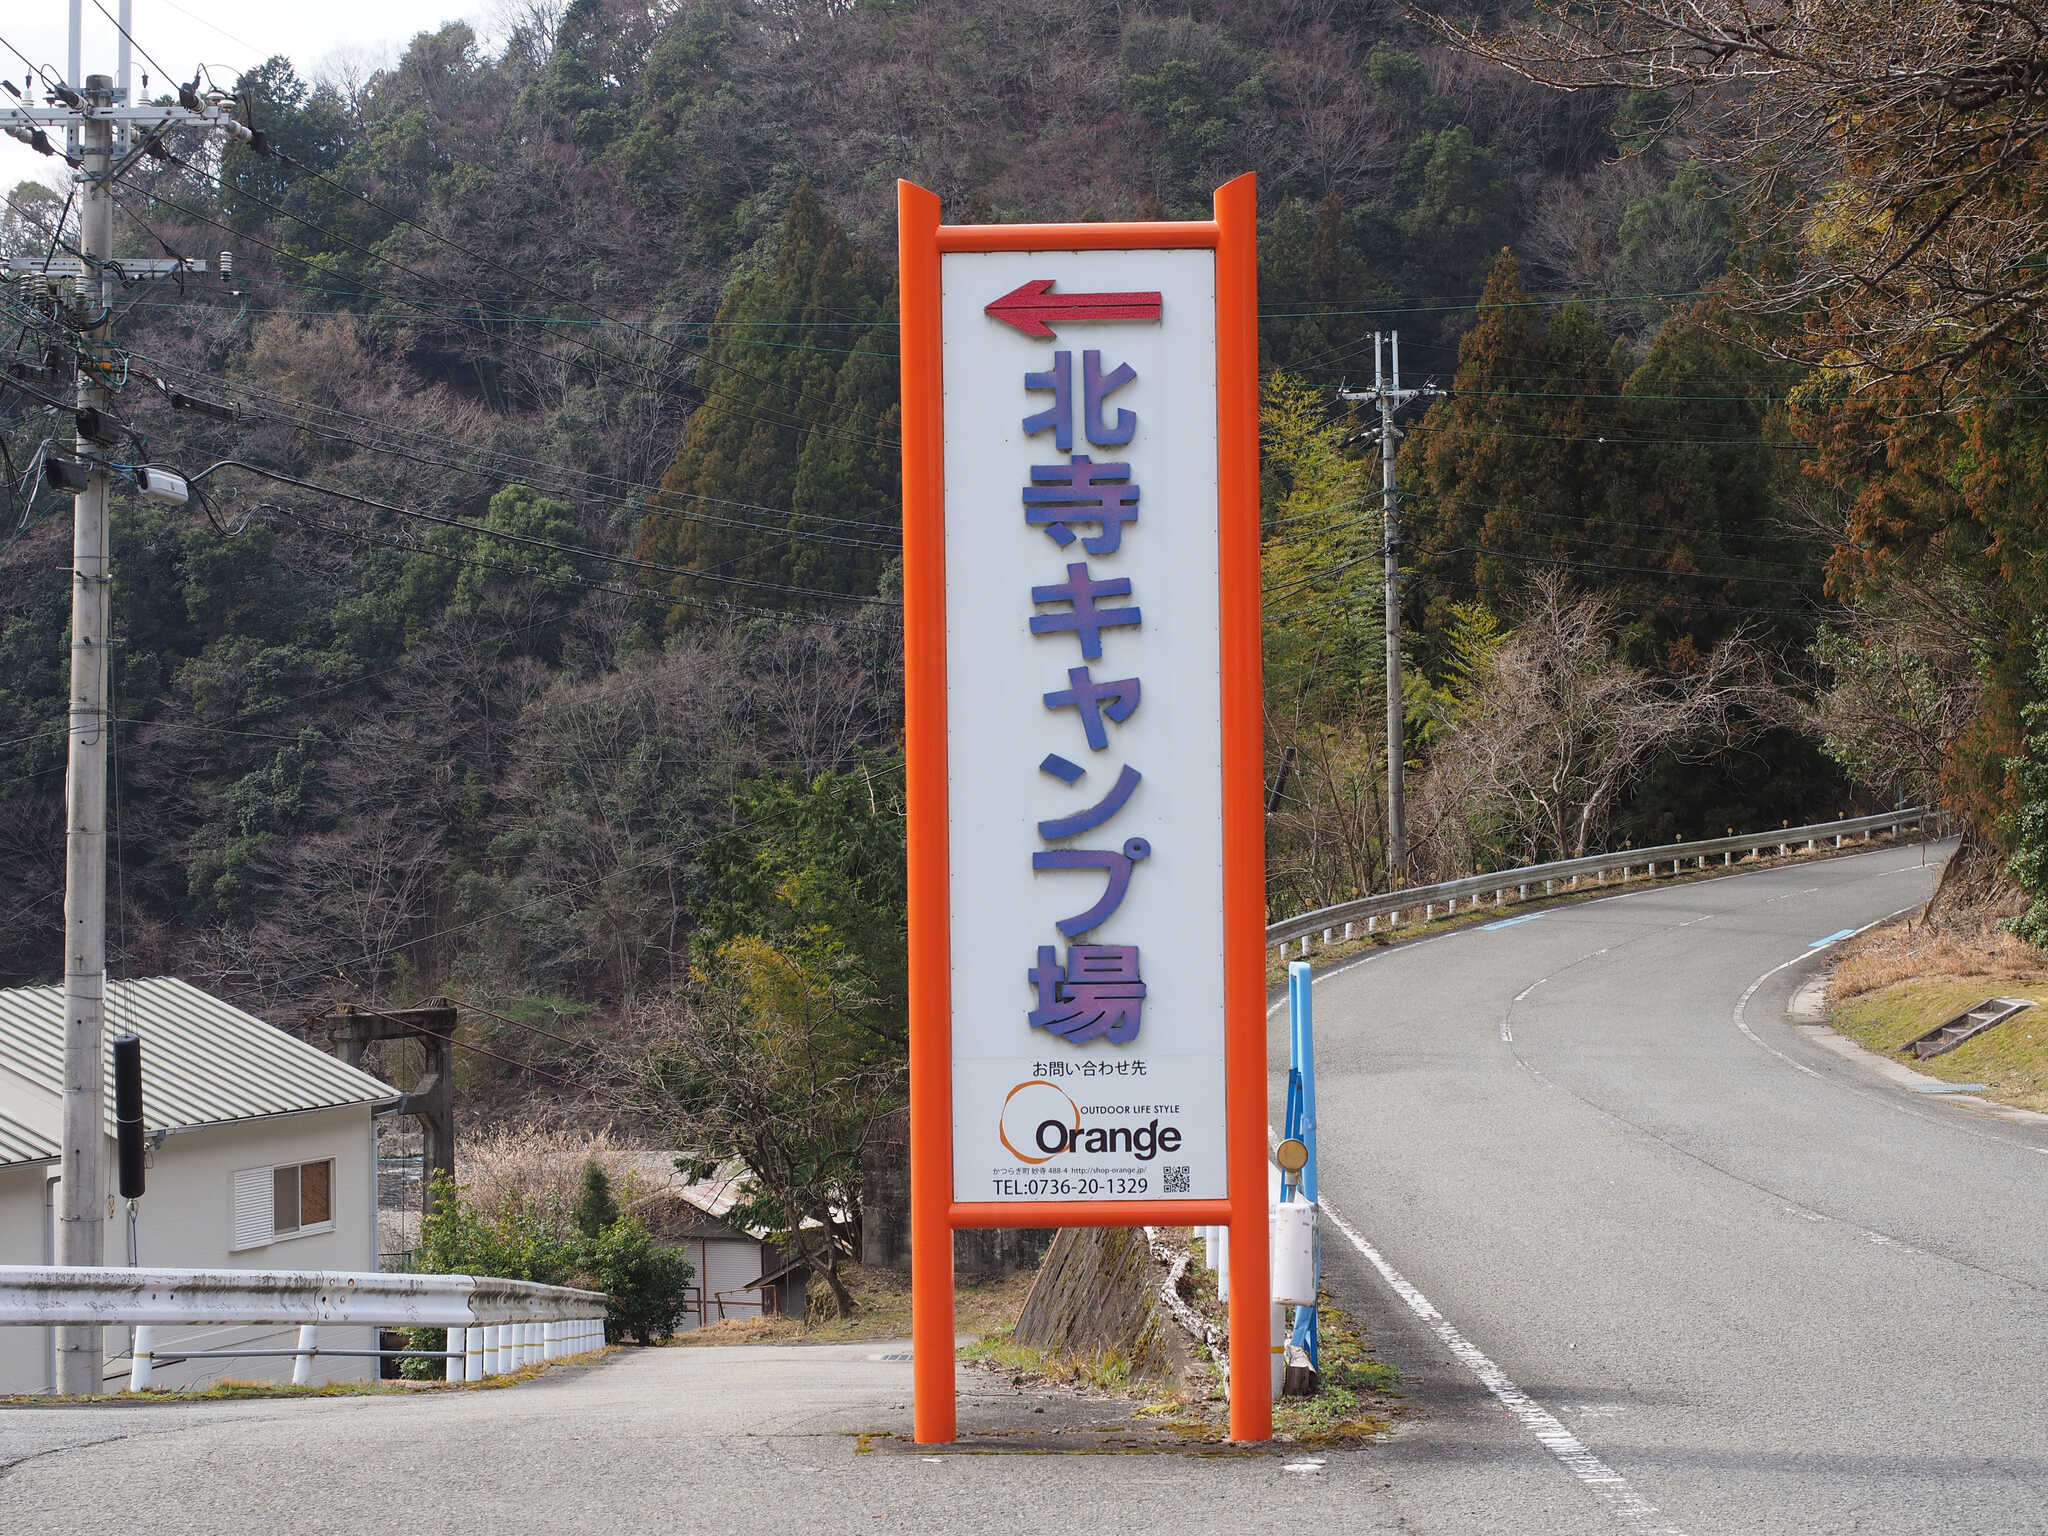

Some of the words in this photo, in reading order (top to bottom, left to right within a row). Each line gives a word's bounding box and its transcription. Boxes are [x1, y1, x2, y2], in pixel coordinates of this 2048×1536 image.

[1022, 349, 1151, 1045] 北寺キャンプ場
[1032, 1060, 1147, 1077] お問い合わせ先
[1080, 1105, 1130, 1115] OUTDOOR
[1133, 1105, 1151, 1114] LIFE
[1154, 1104, 1180, 1114] STYLE
[1035, 1118, 1182, 1161] Orange
[1071, 1166, 1148, 1176] http://shop-orange.jp/
[993, 1177, 1149, 1195] TEL:0736-20-1329
